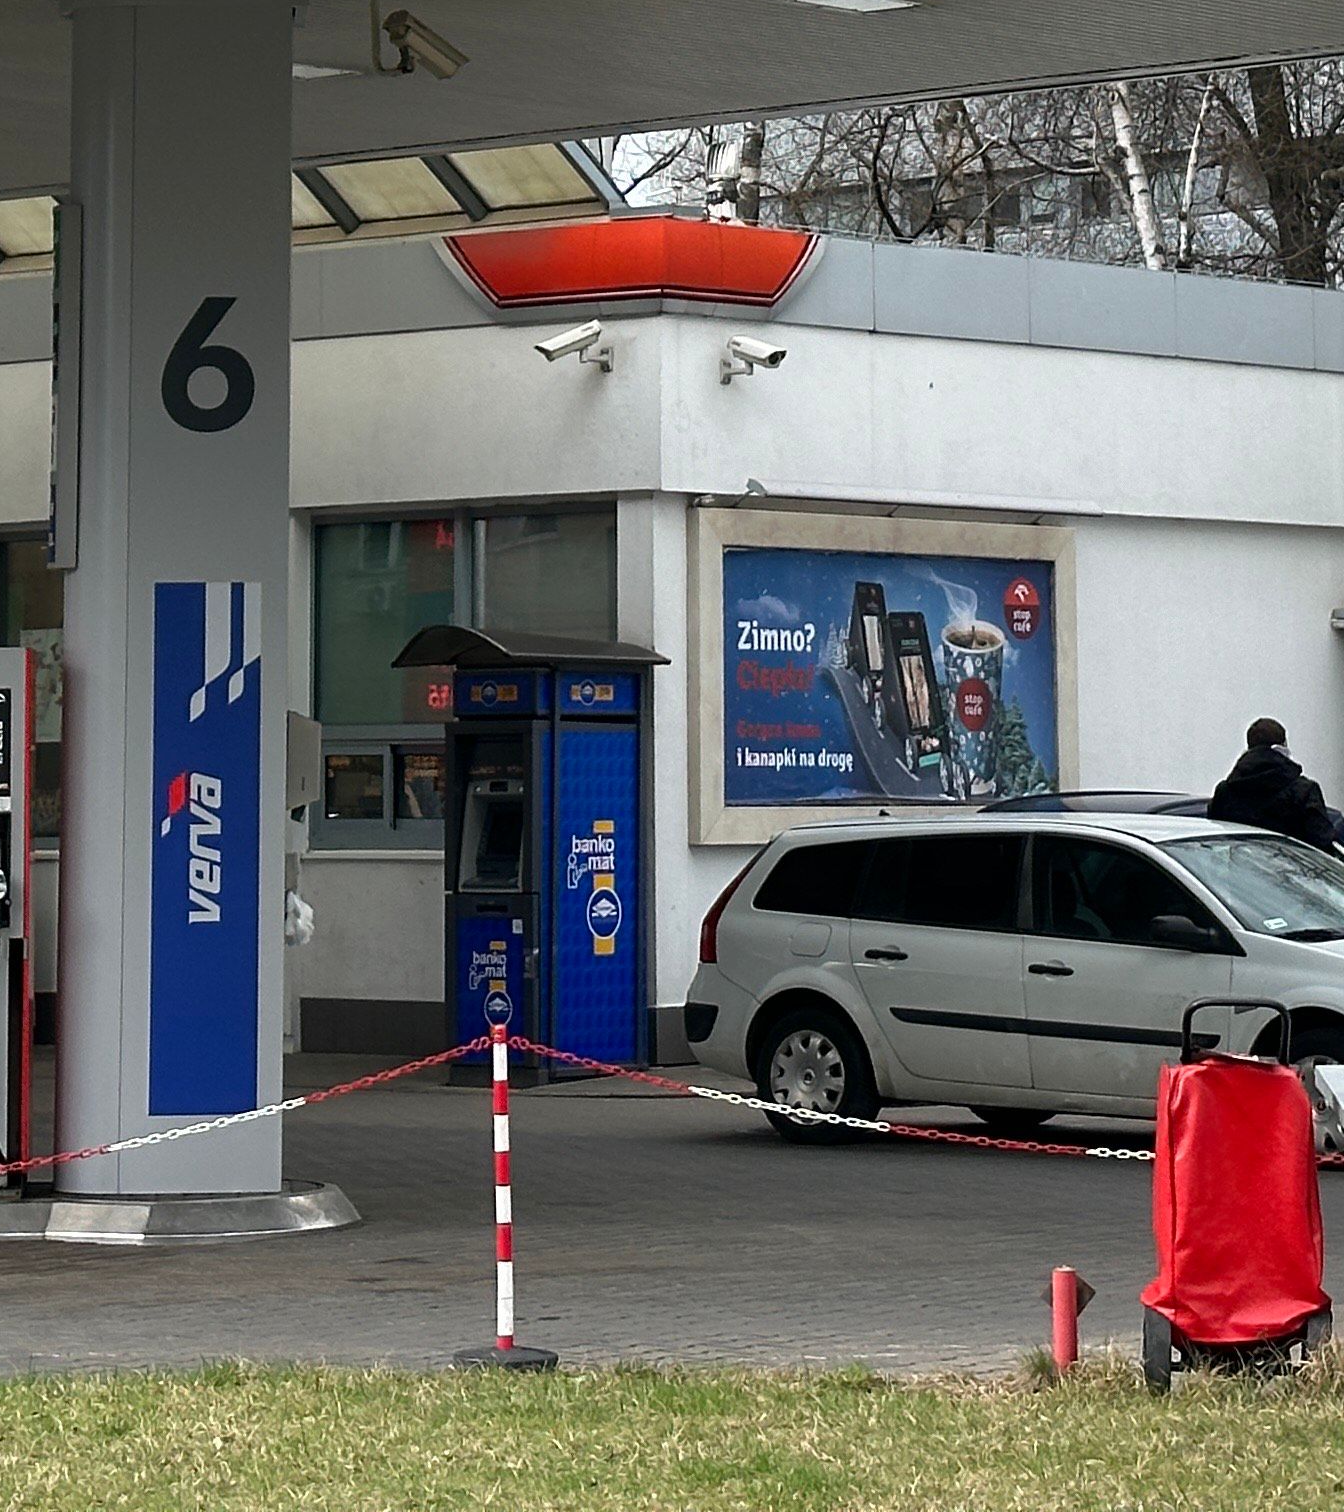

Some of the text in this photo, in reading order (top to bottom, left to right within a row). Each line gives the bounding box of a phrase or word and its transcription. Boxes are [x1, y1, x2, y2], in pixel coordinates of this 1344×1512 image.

[161, 296, 255, 433] 6
[737, 620, 816, 652] Zimno?
[745, 747, 797, 772] kanapki
[799, 752, 816, 767] na
[189, 772, 222, 925] verva
[572, 835, 615, 854] banko
